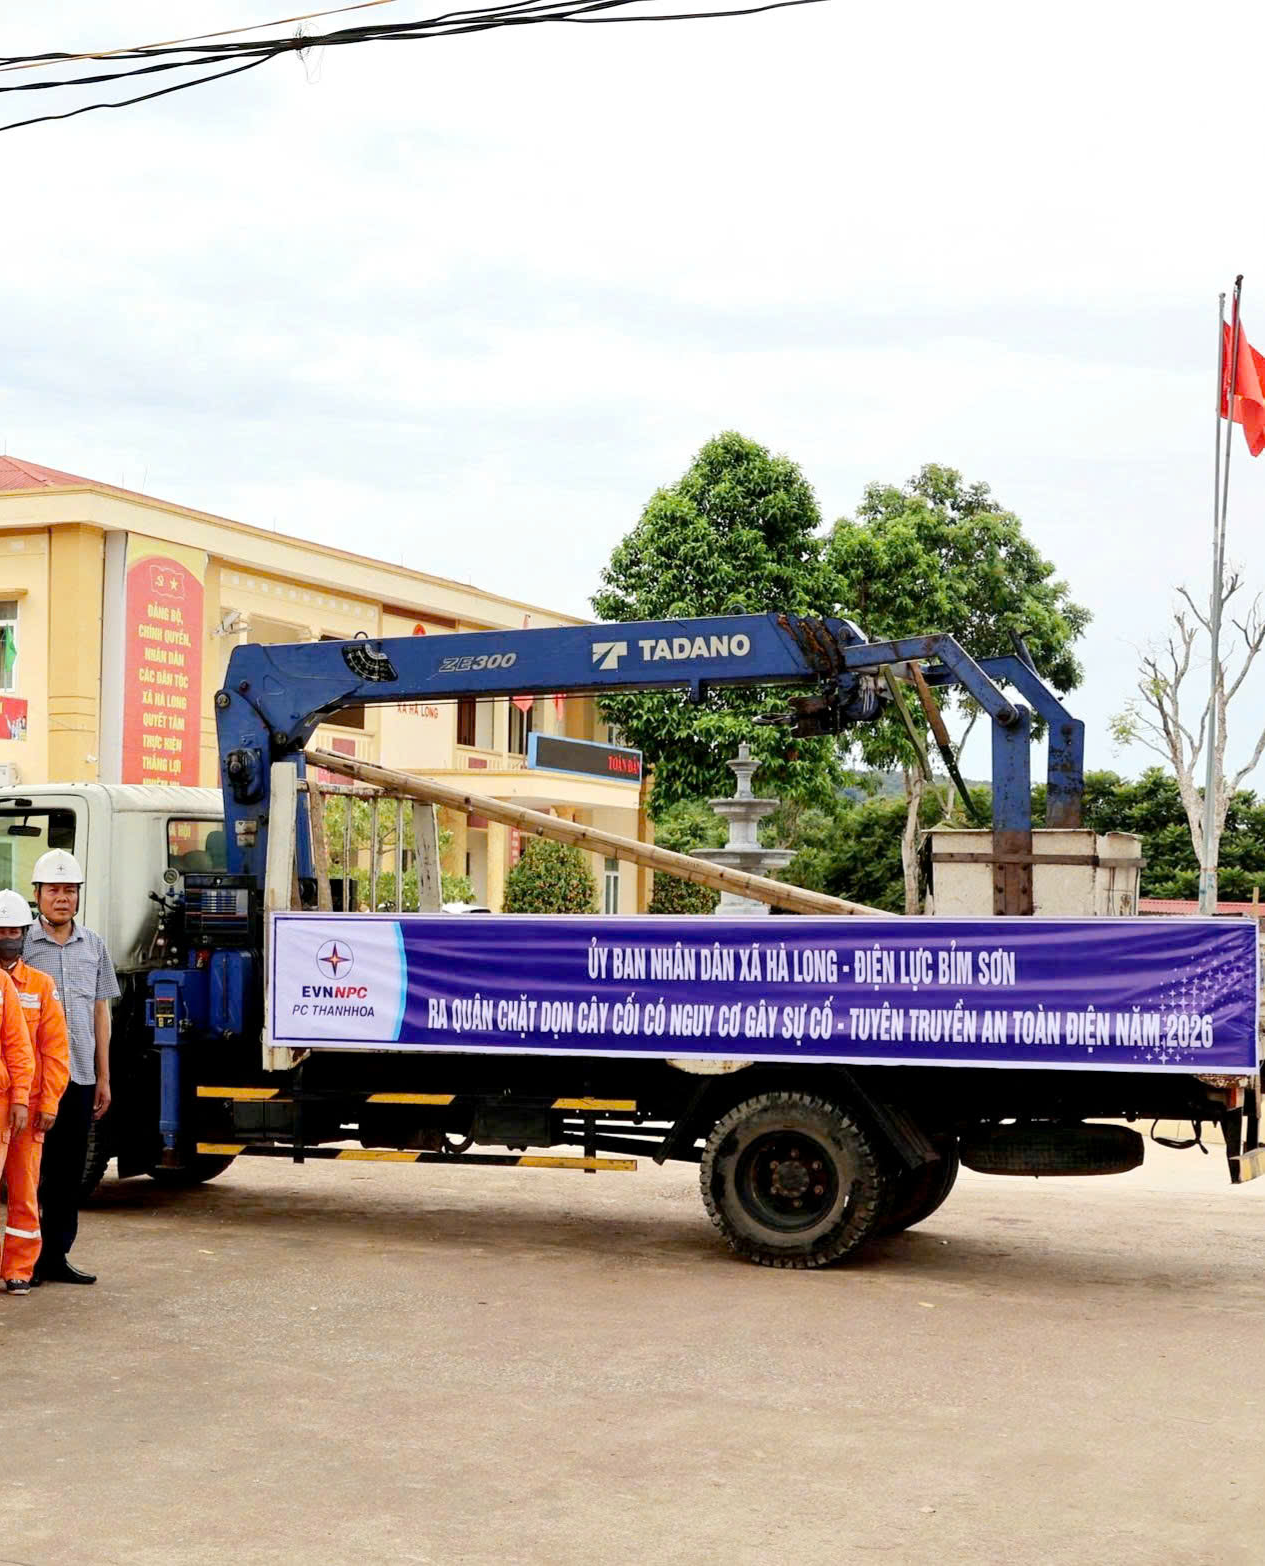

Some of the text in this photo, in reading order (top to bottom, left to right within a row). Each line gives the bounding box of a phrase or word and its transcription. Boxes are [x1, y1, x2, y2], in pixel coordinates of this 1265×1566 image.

[147, 602, 183, 626] ĐẢNG BỘ,
[139, 622, 191, 648] CHÍNH QUYỀN,
[145, 646, 185, 667] NHÂN DÂN
[638, 634, 751, 661] TADANO
[438, 652, 516, 673] ZE300
[139, 666, 189, 690] CÁC DÂN TỘC
[143, 688, 187, 710] XÃ HÀ LONG
[143, 711, 185, 732] QUYẾT TÂM
[421, 705, 439, 719] LONG
[143, 734, 183, 754] THỰC HIỆN
[143, 753, 182, 776] THẮNG LỢI
[607, 753, 627, 772] TOÀN
[588, 936, 608, 980] ỦY
[613, 946, 645, 980] BAN
[651, 941, 695, 981] NHÂN
[701, 942, 735, 982] DÂN
[739, 942, 763, 982] XÃ
[766, 942, 789, 982] HÀ
[793, 949, 837, 983] LONG
[854, 944, 895, 991] ĐIỆN
[900, 948, 933, 991] LỰC
[938, 940, 973, 985] BỈM
[978, 948, 1015, 986] SƠN
[302, 985, 368, 999] EVNNPC
[292, 1004, 375, 1018] PC THANHHOA
[428, 998, 447, 1030] RA
[452, 993, 493, 1033] QUÂN
[497, 994, 537, 1038] CHẶT
[540, 1000, 573, 1040] DỌN
[577, 995, 609, 1035] CÂY
[613, 992, 639, 1036] CỐI
[643, 996, 666, 1037] CÓ
[669, 1004, 715, 1038] NGUY
[718, 1002, 743, 1038] CƠ
[744, 1000, 778, 1038] GÂY
[782, 1003, 808, 1046] SỰ
[809, 995, 834, 1040] CỐ
[849, 1001, 904, 1041] TUYÊN
[909, 998, 976, 1044] TRUYỀN
[981, 1010, 1007, 1044] AN
[1013, 1004, 1061, 1045] TOÀN
[1066, 1005, 1110, 1054] ĐIỆN
[1116, 1005, 1161, 1047] NĂM
[1166, 1013, 1213, 1048] 2026
